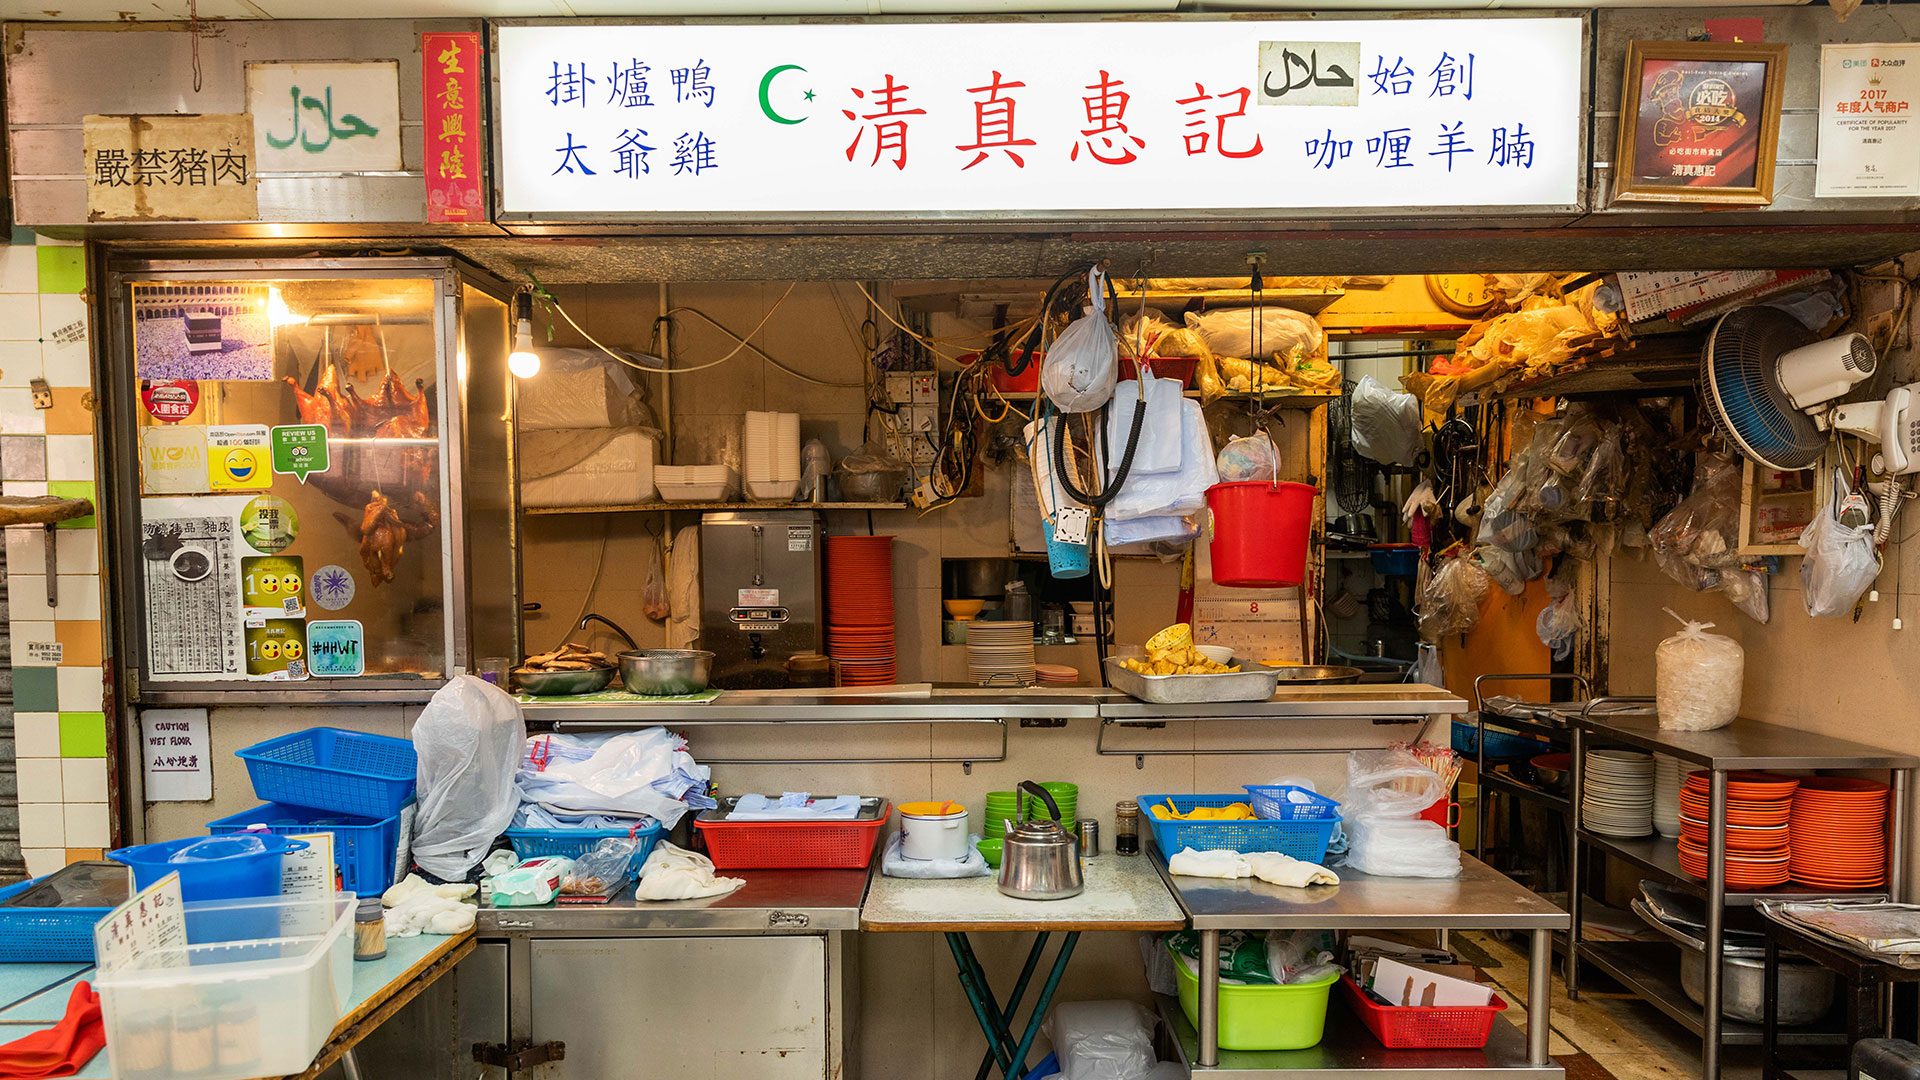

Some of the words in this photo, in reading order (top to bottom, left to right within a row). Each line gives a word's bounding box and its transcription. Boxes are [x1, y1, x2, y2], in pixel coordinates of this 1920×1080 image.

[1263, 47, 1355, 99] حلال
[1367, 51, 1475, 102] 始創
[546, 57, 716, 110] 掛爐鴨
[1695, 89, 1728, 106] 必吃
[1860, 89, 1887, 100] 2017
[436, 39, 467, 180] 生意興隆
[1836, 101, 1909, 114] 年度人气商户
[266, 84, 380, 154] حلال
[841, 69, 1265, 172] 清真惠記
[552, 128, 720, 181] 太爺雞
[1304, 123, 1536, 173] 咖喱羊腩
[94, 148, 249, 188] 嚴禁豬肉
[1671, 164, 1717, 177] 清真惠記
[151, 403, 190, 415] 入圍食店
[259, 508, 279, 519] 投我
[1250, 602, 1259, 613] 8
[312, 639, 359, 656] #HHWT
[155, 721, 190, 732] CAUTION
[149, 736, 166, 746] WET
[170, 736, 192, 746] FLOOR
[153, 754, 198, 768] 小心地滑
